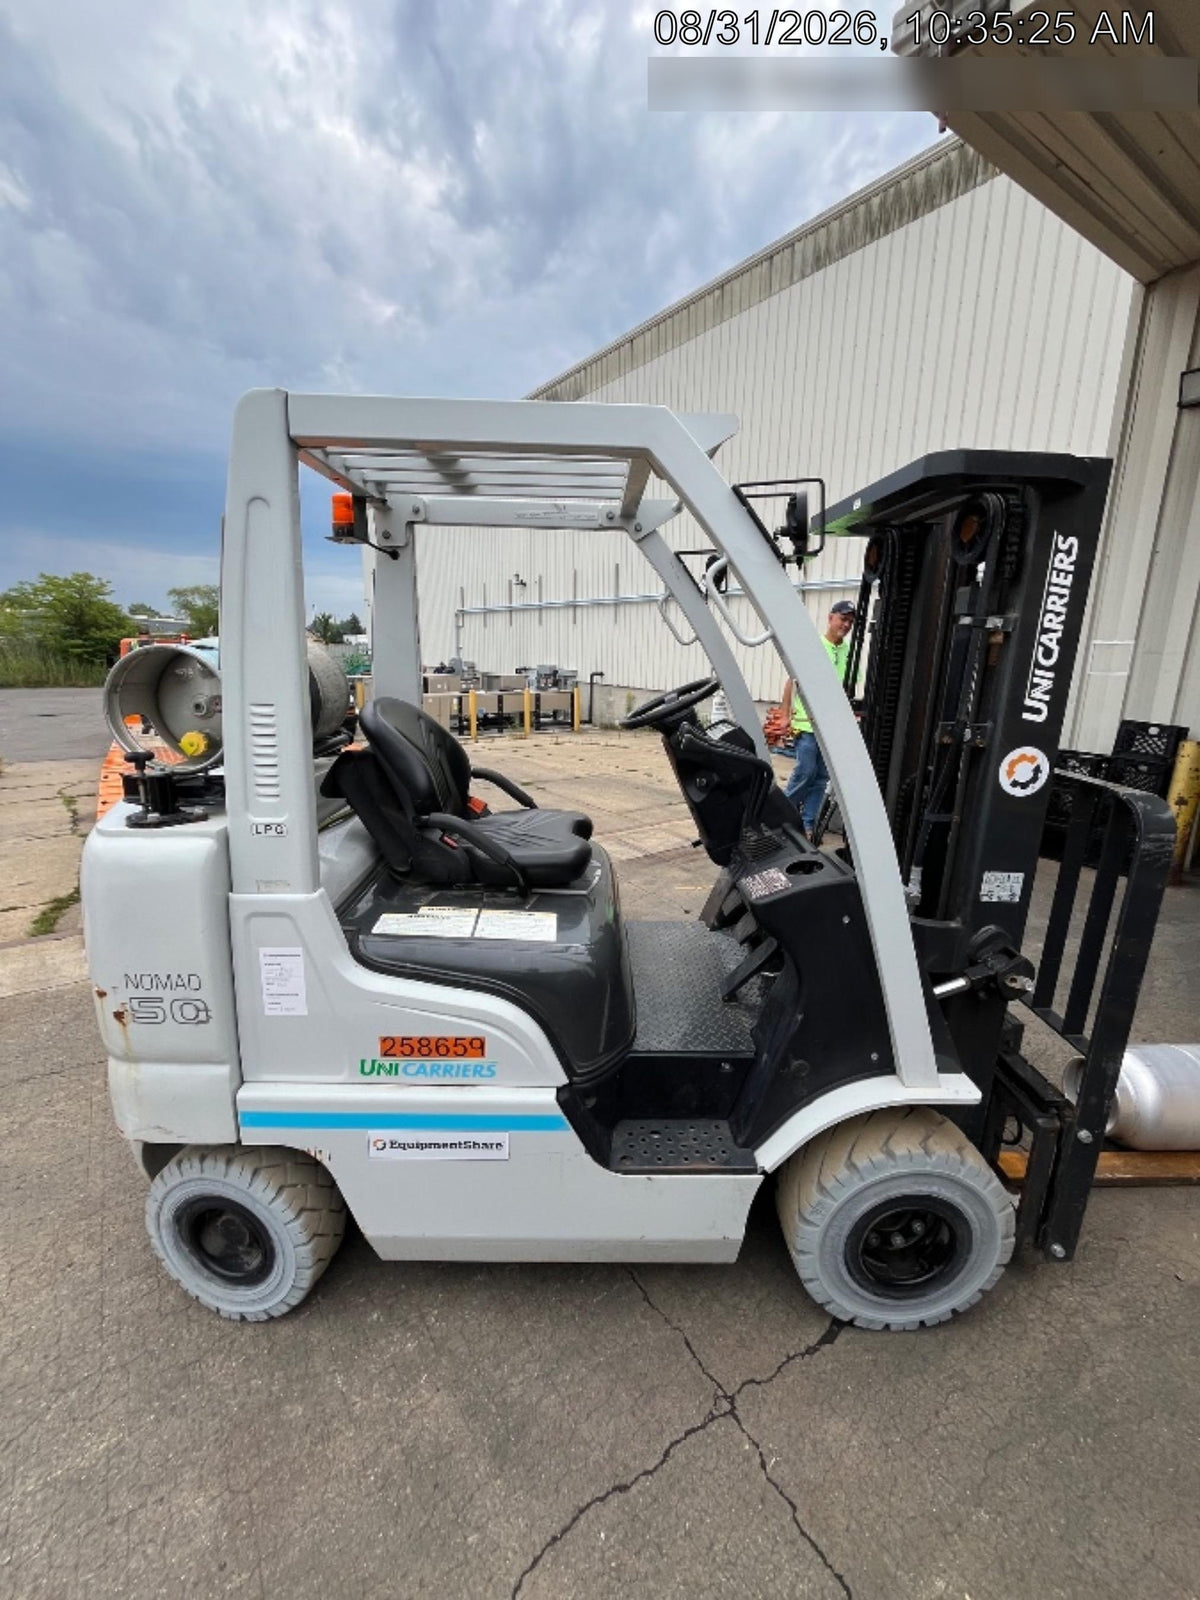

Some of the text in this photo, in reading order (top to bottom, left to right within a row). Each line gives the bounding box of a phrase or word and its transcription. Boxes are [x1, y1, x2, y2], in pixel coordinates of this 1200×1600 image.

[123, 973, 202, 991] NOMAD
[382, 1036, 485, 1057] 258659
[388, 1140, 504, 1152] EquipmentShare
